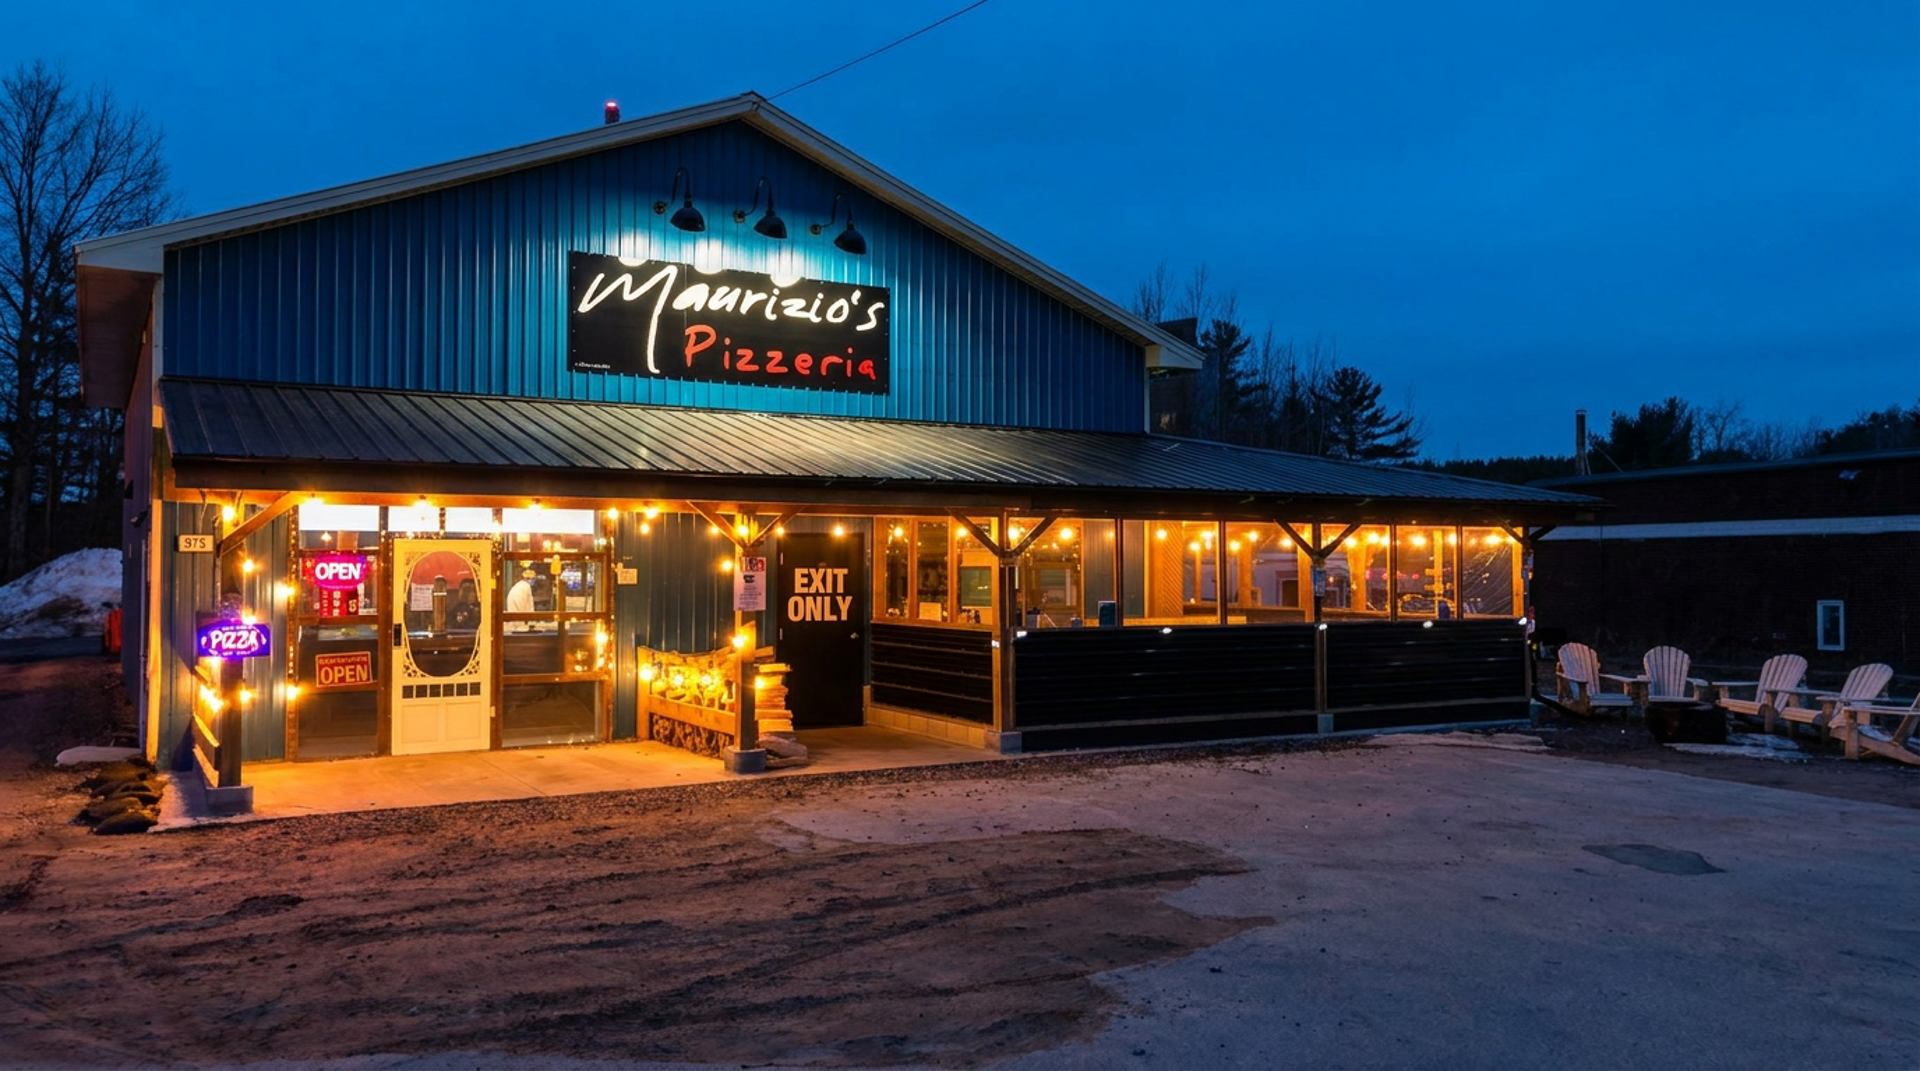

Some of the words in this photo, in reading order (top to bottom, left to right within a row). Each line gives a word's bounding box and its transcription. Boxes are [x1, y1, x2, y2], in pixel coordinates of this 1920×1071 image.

[578, 264, 885, 374] Maurizio's
[684, 324, 876, 380] Pizzeria
[315, 562, 361, 580] OPEN
[795, 568, 849, 593] EXIT
[788, 596, 853, 622] ONLY
[210, 630, 258, 652] PIZZA
[321, 664, 368, 684] OPEN
